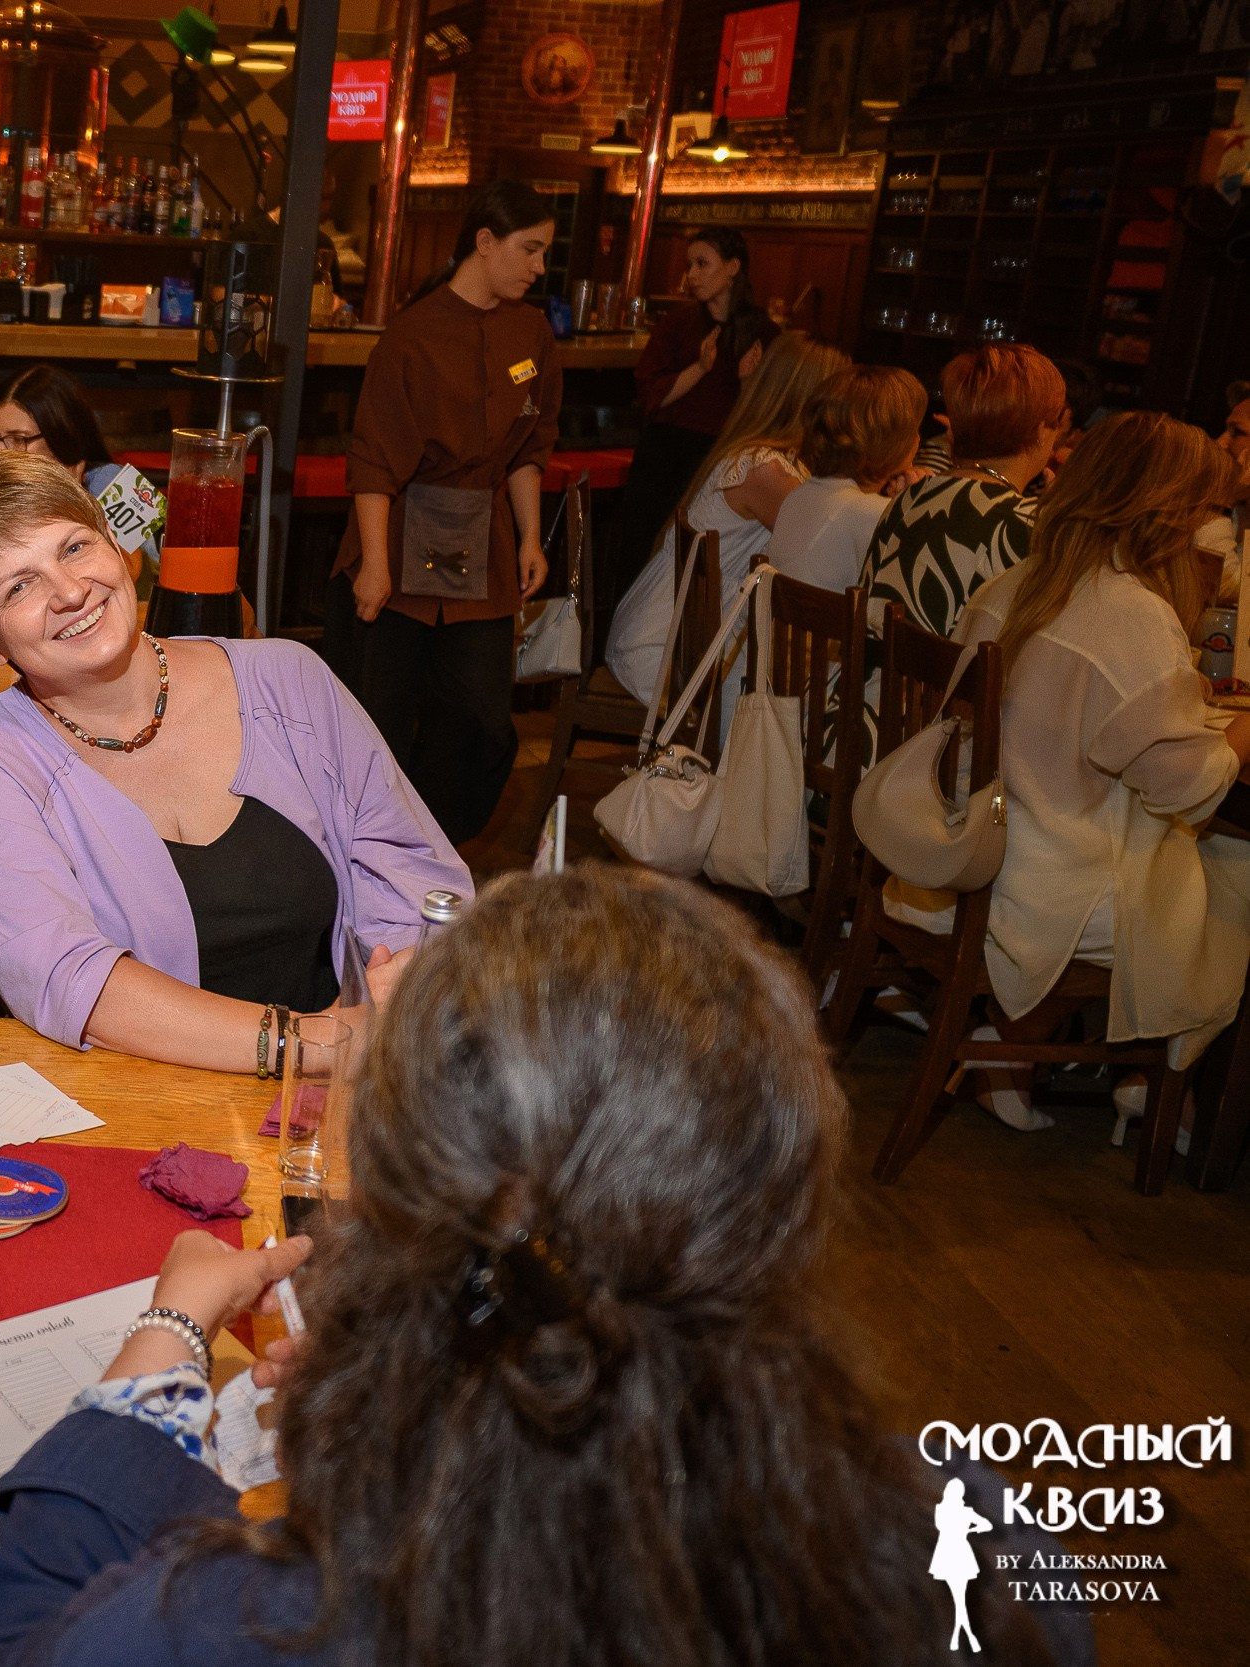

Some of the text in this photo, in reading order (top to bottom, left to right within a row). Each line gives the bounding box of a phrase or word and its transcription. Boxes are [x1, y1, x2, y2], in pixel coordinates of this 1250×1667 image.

[337, 103, 366, 116] КВИЗ
[105, 500, 146, 535] 407
[36, 1316, 76, 1336] очков
